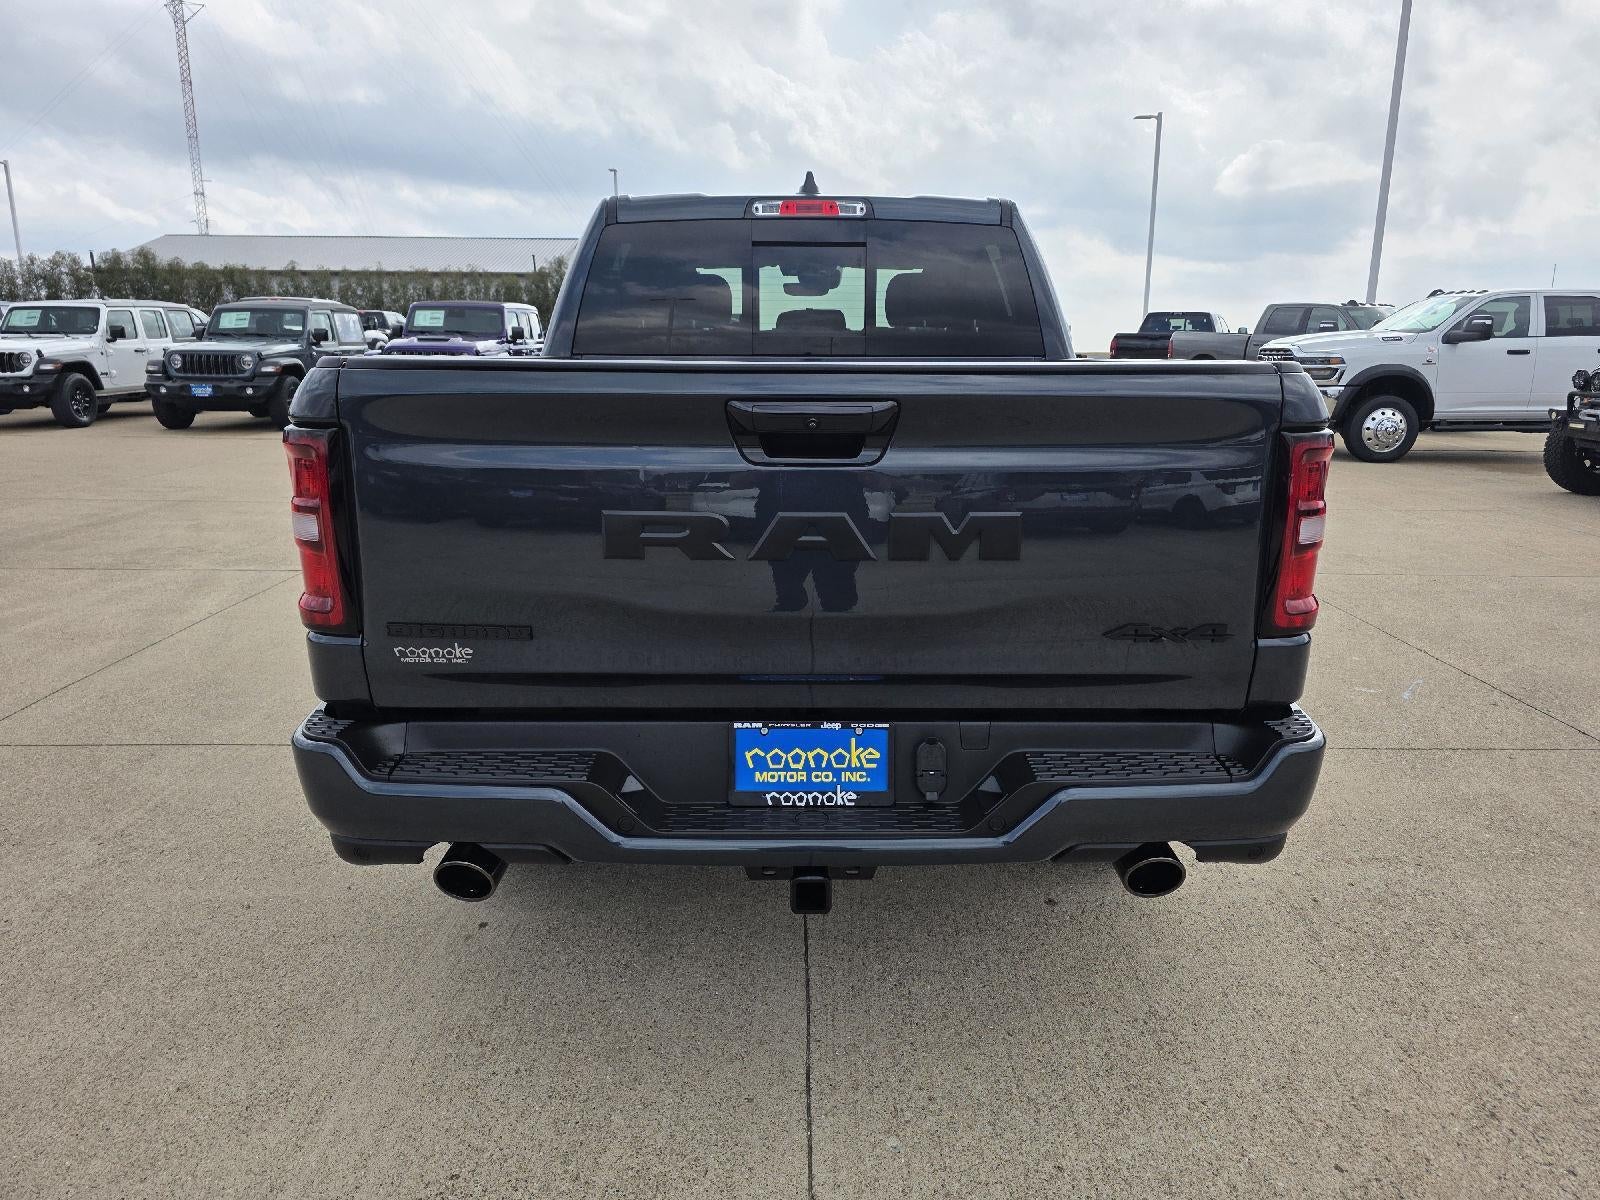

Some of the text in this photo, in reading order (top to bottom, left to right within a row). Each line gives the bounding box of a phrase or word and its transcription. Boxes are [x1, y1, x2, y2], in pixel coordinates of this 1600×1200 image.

[602, 510, 1023, 561] RAM
[820, 721, 842, 731] Jeep
[755, 771, 871, 783] MOTOR CO. INC.
